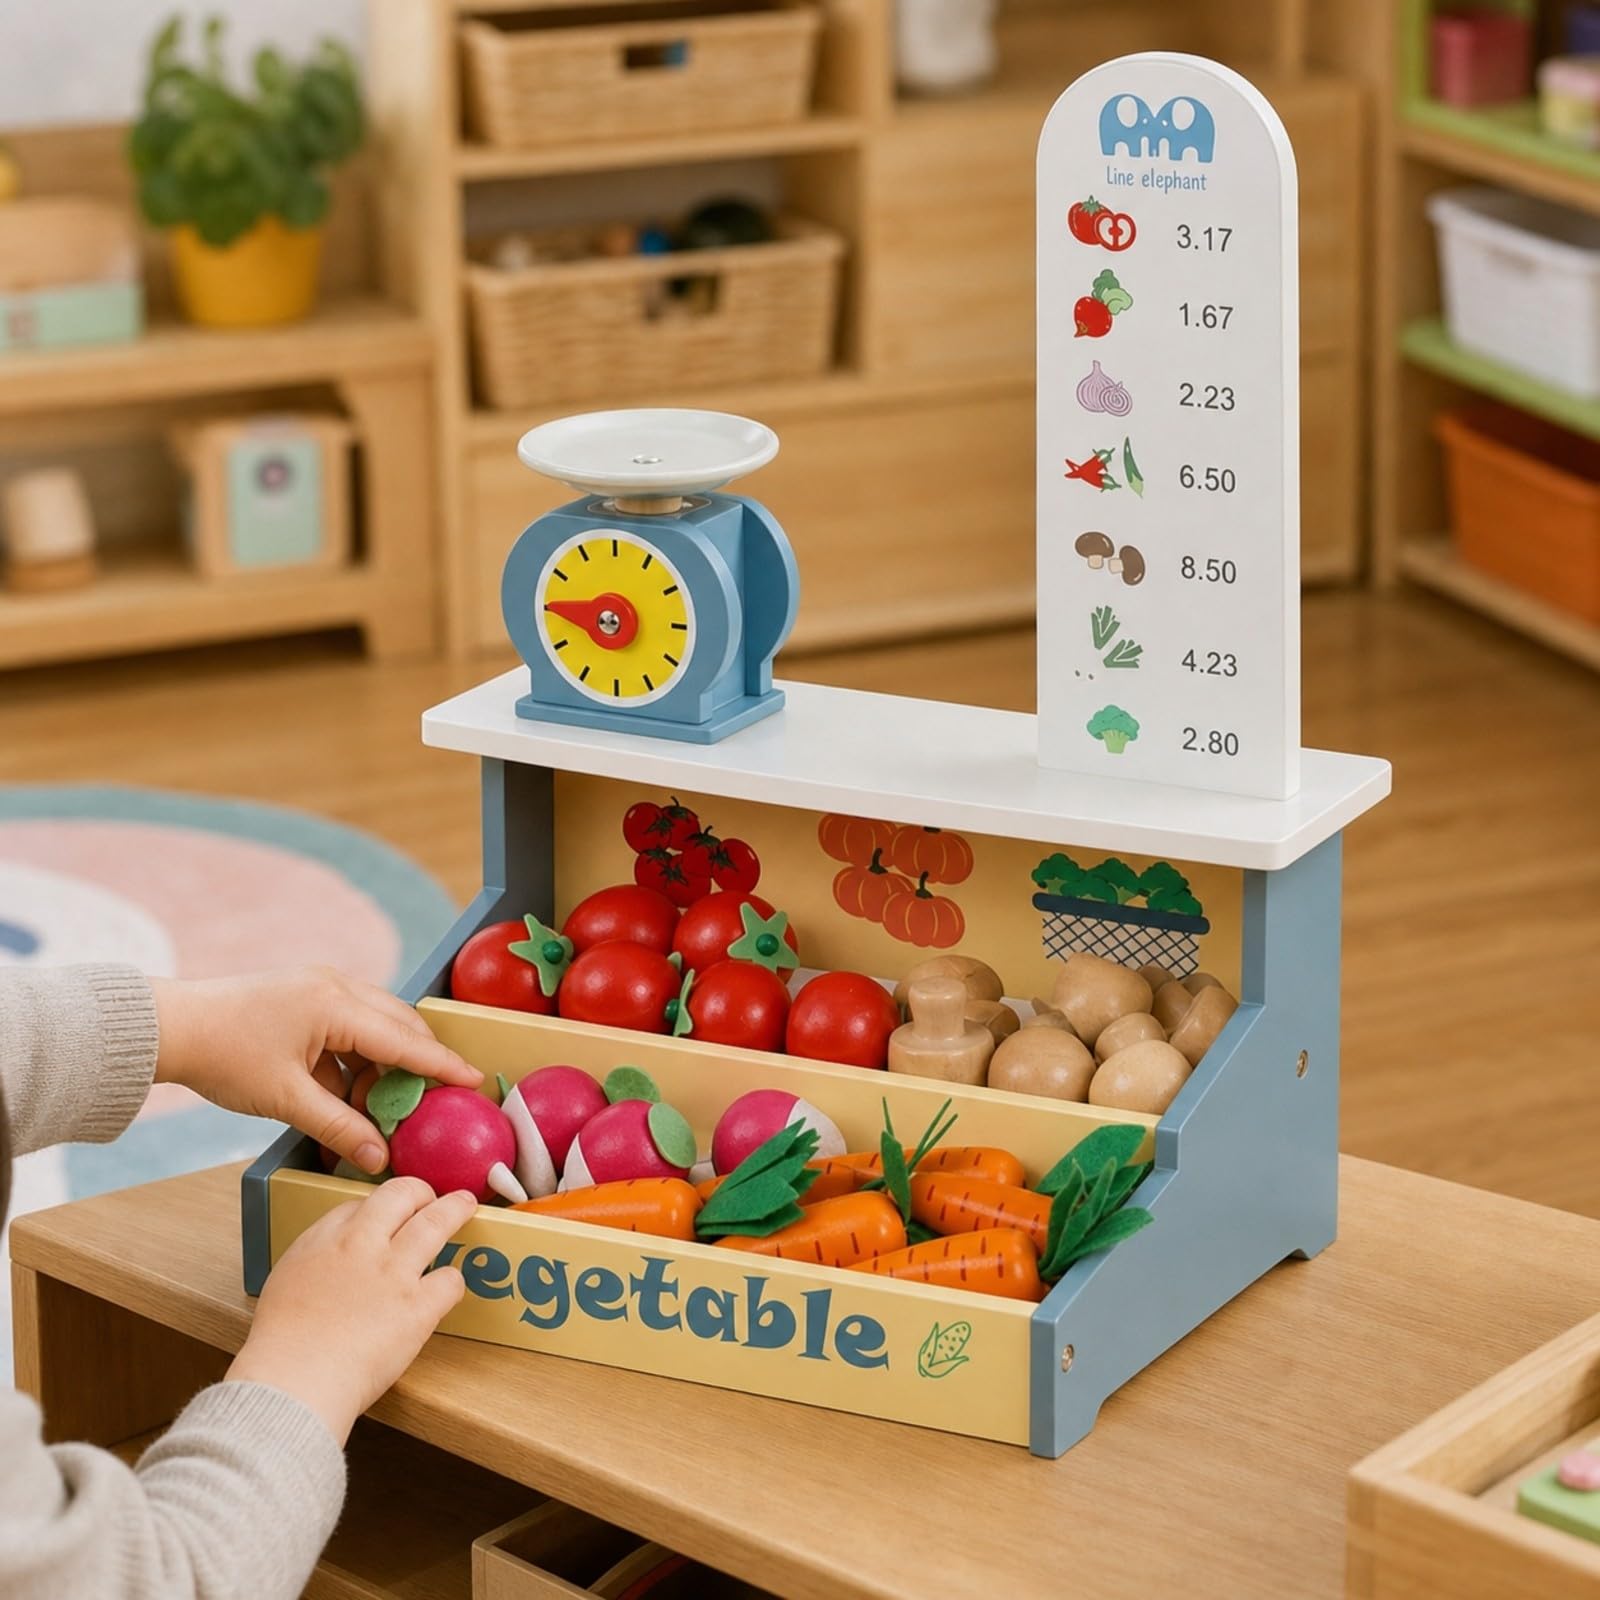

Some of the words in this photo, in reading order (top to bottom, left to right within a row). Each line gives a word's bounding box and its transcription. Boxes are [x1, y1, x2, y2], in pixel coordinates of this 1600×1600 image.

[1106, 165, 1134, 187] Line
[1141, 167, 1207, 194] elephant
[1176, 223, 1233, 253] 3.17
[1178, 302, 1234, 331] 1.67
[1179, 382, 1236, 412] 2.23
[1179, 464, 1236, 494] 6.50
[1180, 555, 1237, 585] 8.50
[1180, 648, 1238, 678] 4.23
[1181, 726, 1240, 757] 2.80
